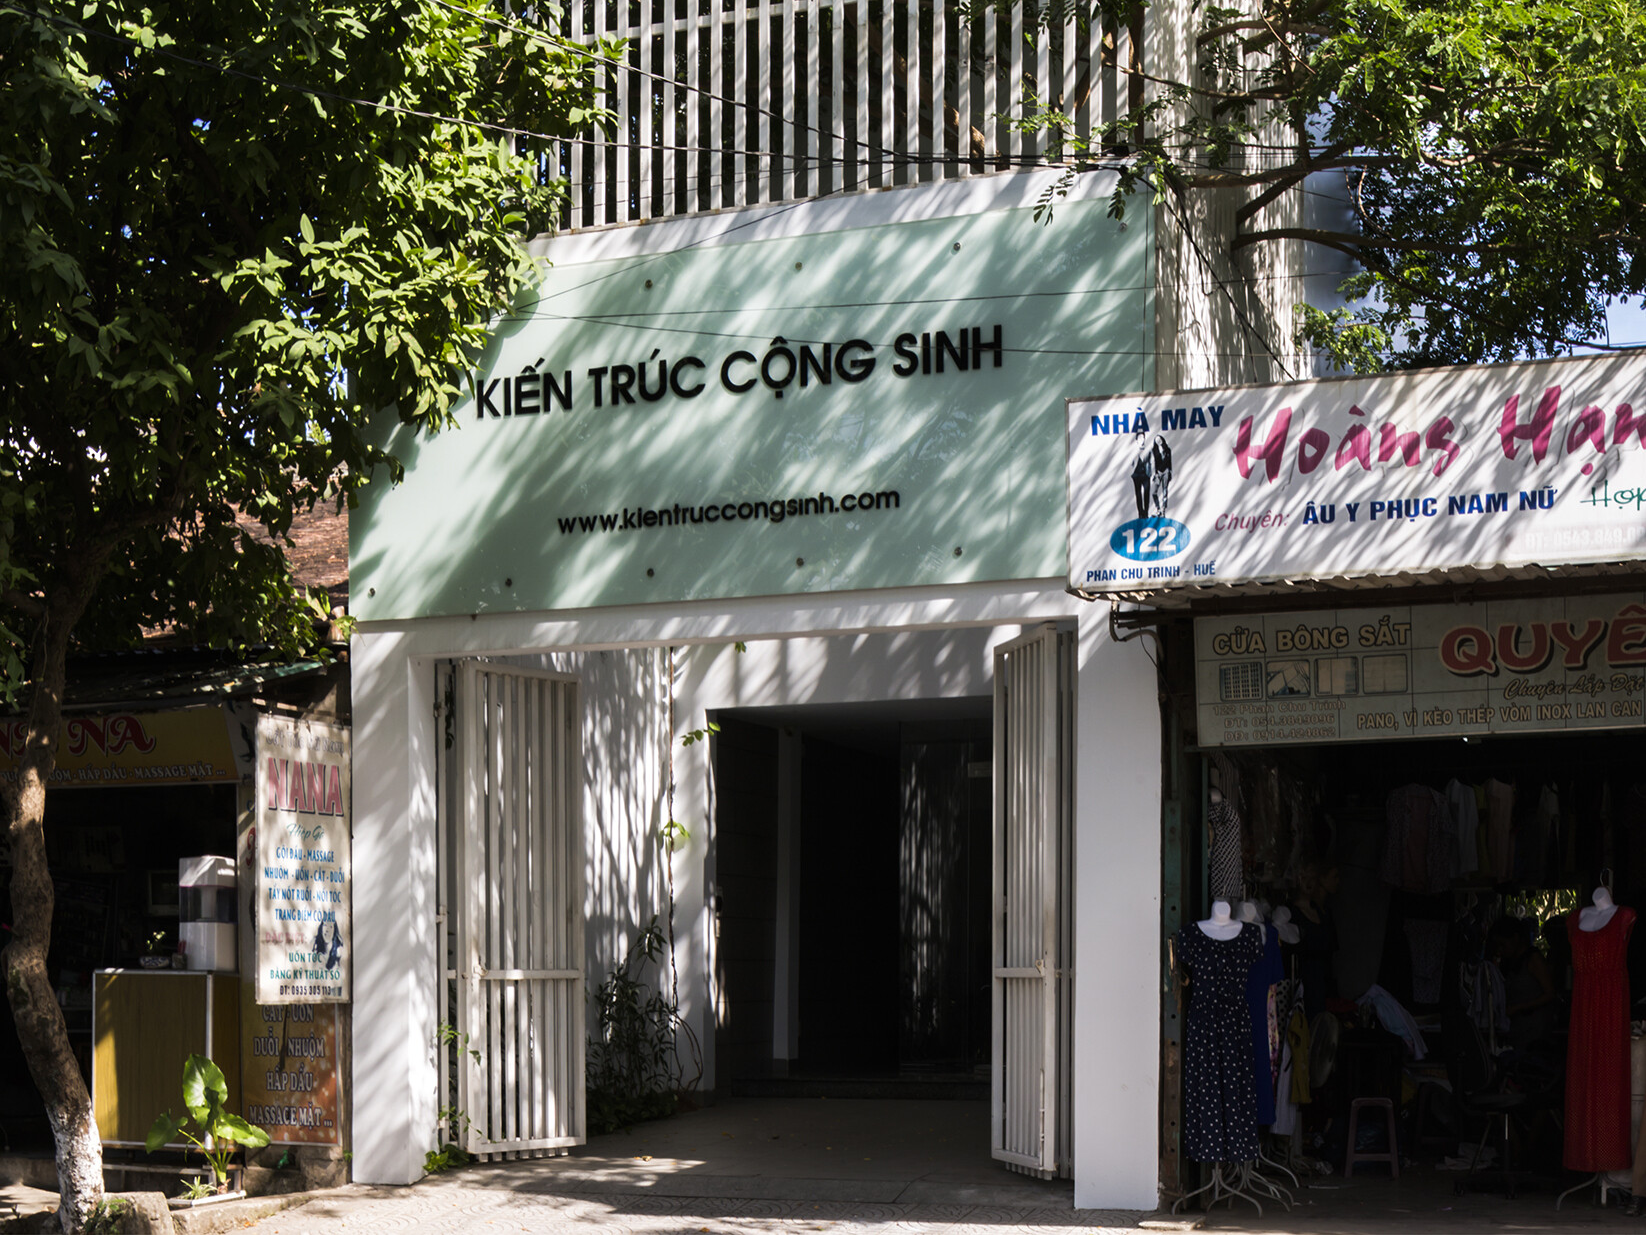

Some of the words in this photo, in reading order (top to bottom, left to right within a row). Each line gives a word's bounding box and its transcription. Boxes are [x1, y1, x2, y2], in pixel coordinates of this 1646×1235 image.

[477, 357, 573, 419] KIẾN
[588, 348, 706, 408] TRÚC
[720, 336, 877, 399] CỘNG
[892, 324, 1003, 377] SINH
[1091, 406, 1150, 436] NHÀ
[1161, 405, 1225, 431] MAY
[1232, 404, 1461, 484] Hoàng
[557, 489, 901, 534] www.kientruccongsinh.com
[1302, 500, 1336, 526] ÂU
[1345, 502, 1361, 523] Y
[1370, 497, 1438, 522] PHỤC
[1448, 492, 1509, 516] NAM
[1519, 485, 1558, 511] NỮ
[1122, 526, 1177, 554] 122
[1086, 569, 1117, 583] PHAN
[1121, 567, 1143, 580] CHU
[1147, 565, 1180, 579] TRINH
[1193, 560, 1216, 576] HUẾ
[1213, 626, 1267, 655] CỬA
[1276, 624, 1349, 653] BÔNG
[1359, 615, 1412, 647] SẮT
[1503, 678, 1567, 701] Chuyên
[1240, 702, 1275, 714] Phan
[1357, 713, 1399, 730] PANO,
[1403, 707, 1418, 727] VÌ
[1423, 706, 1453, 726] KÈO
[1457, 704, 1496, 724] THÉP
[1500, 702, 1532, 722] VÒM
[1536, 703, 1572, 721] INOX
[1577, 700, 1607, 718] LAN
[1611, 699, 1643, 717] CAN
[134, 766, 187, 780] MASSAGE
[268, 757, 345, 817] NANA
[306, 849, 335, 863] MASSAGE
[275, 908, 297, 921] TRANG
